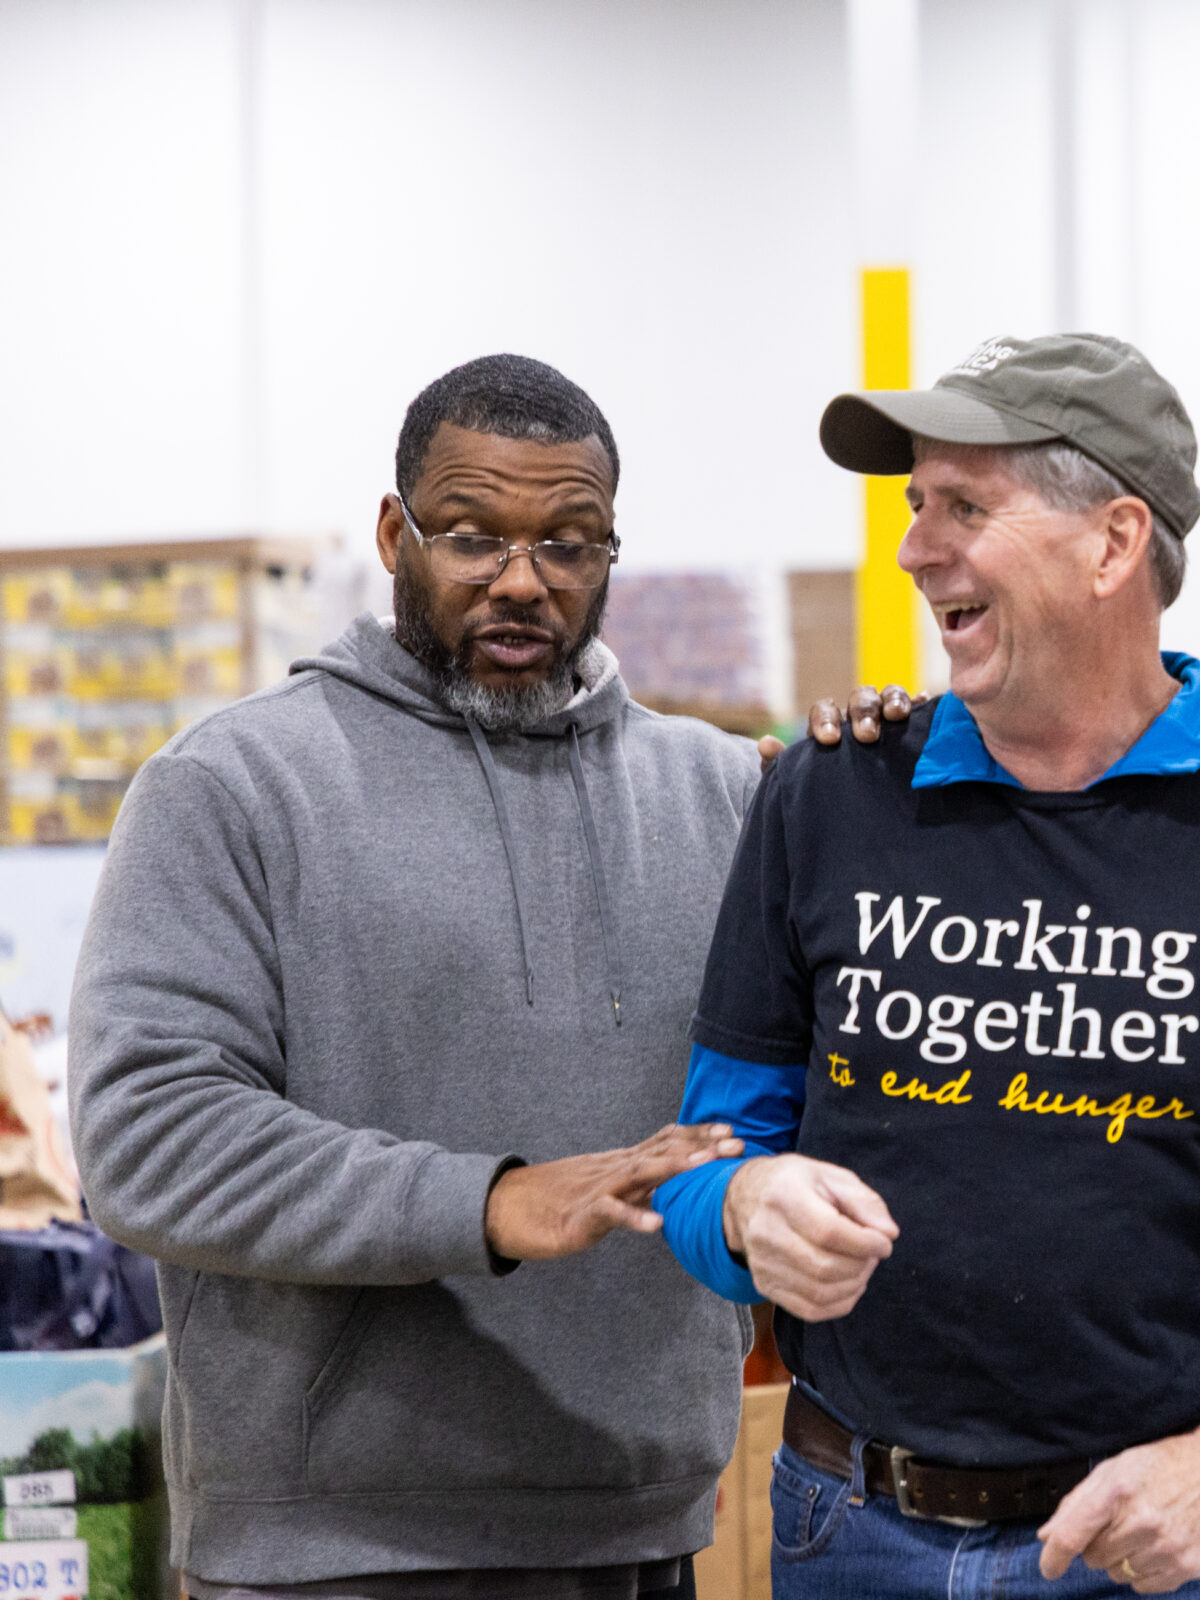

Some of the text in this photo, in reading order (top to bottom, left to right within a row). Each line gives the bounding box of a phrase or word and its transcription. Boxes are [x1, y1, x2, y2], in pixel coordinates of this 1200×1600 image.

[854, 891, 1198, 1000] Working
[836, 966, 1200, 1064] Together
[828, 1052, 1195, 1144] to end hunger
